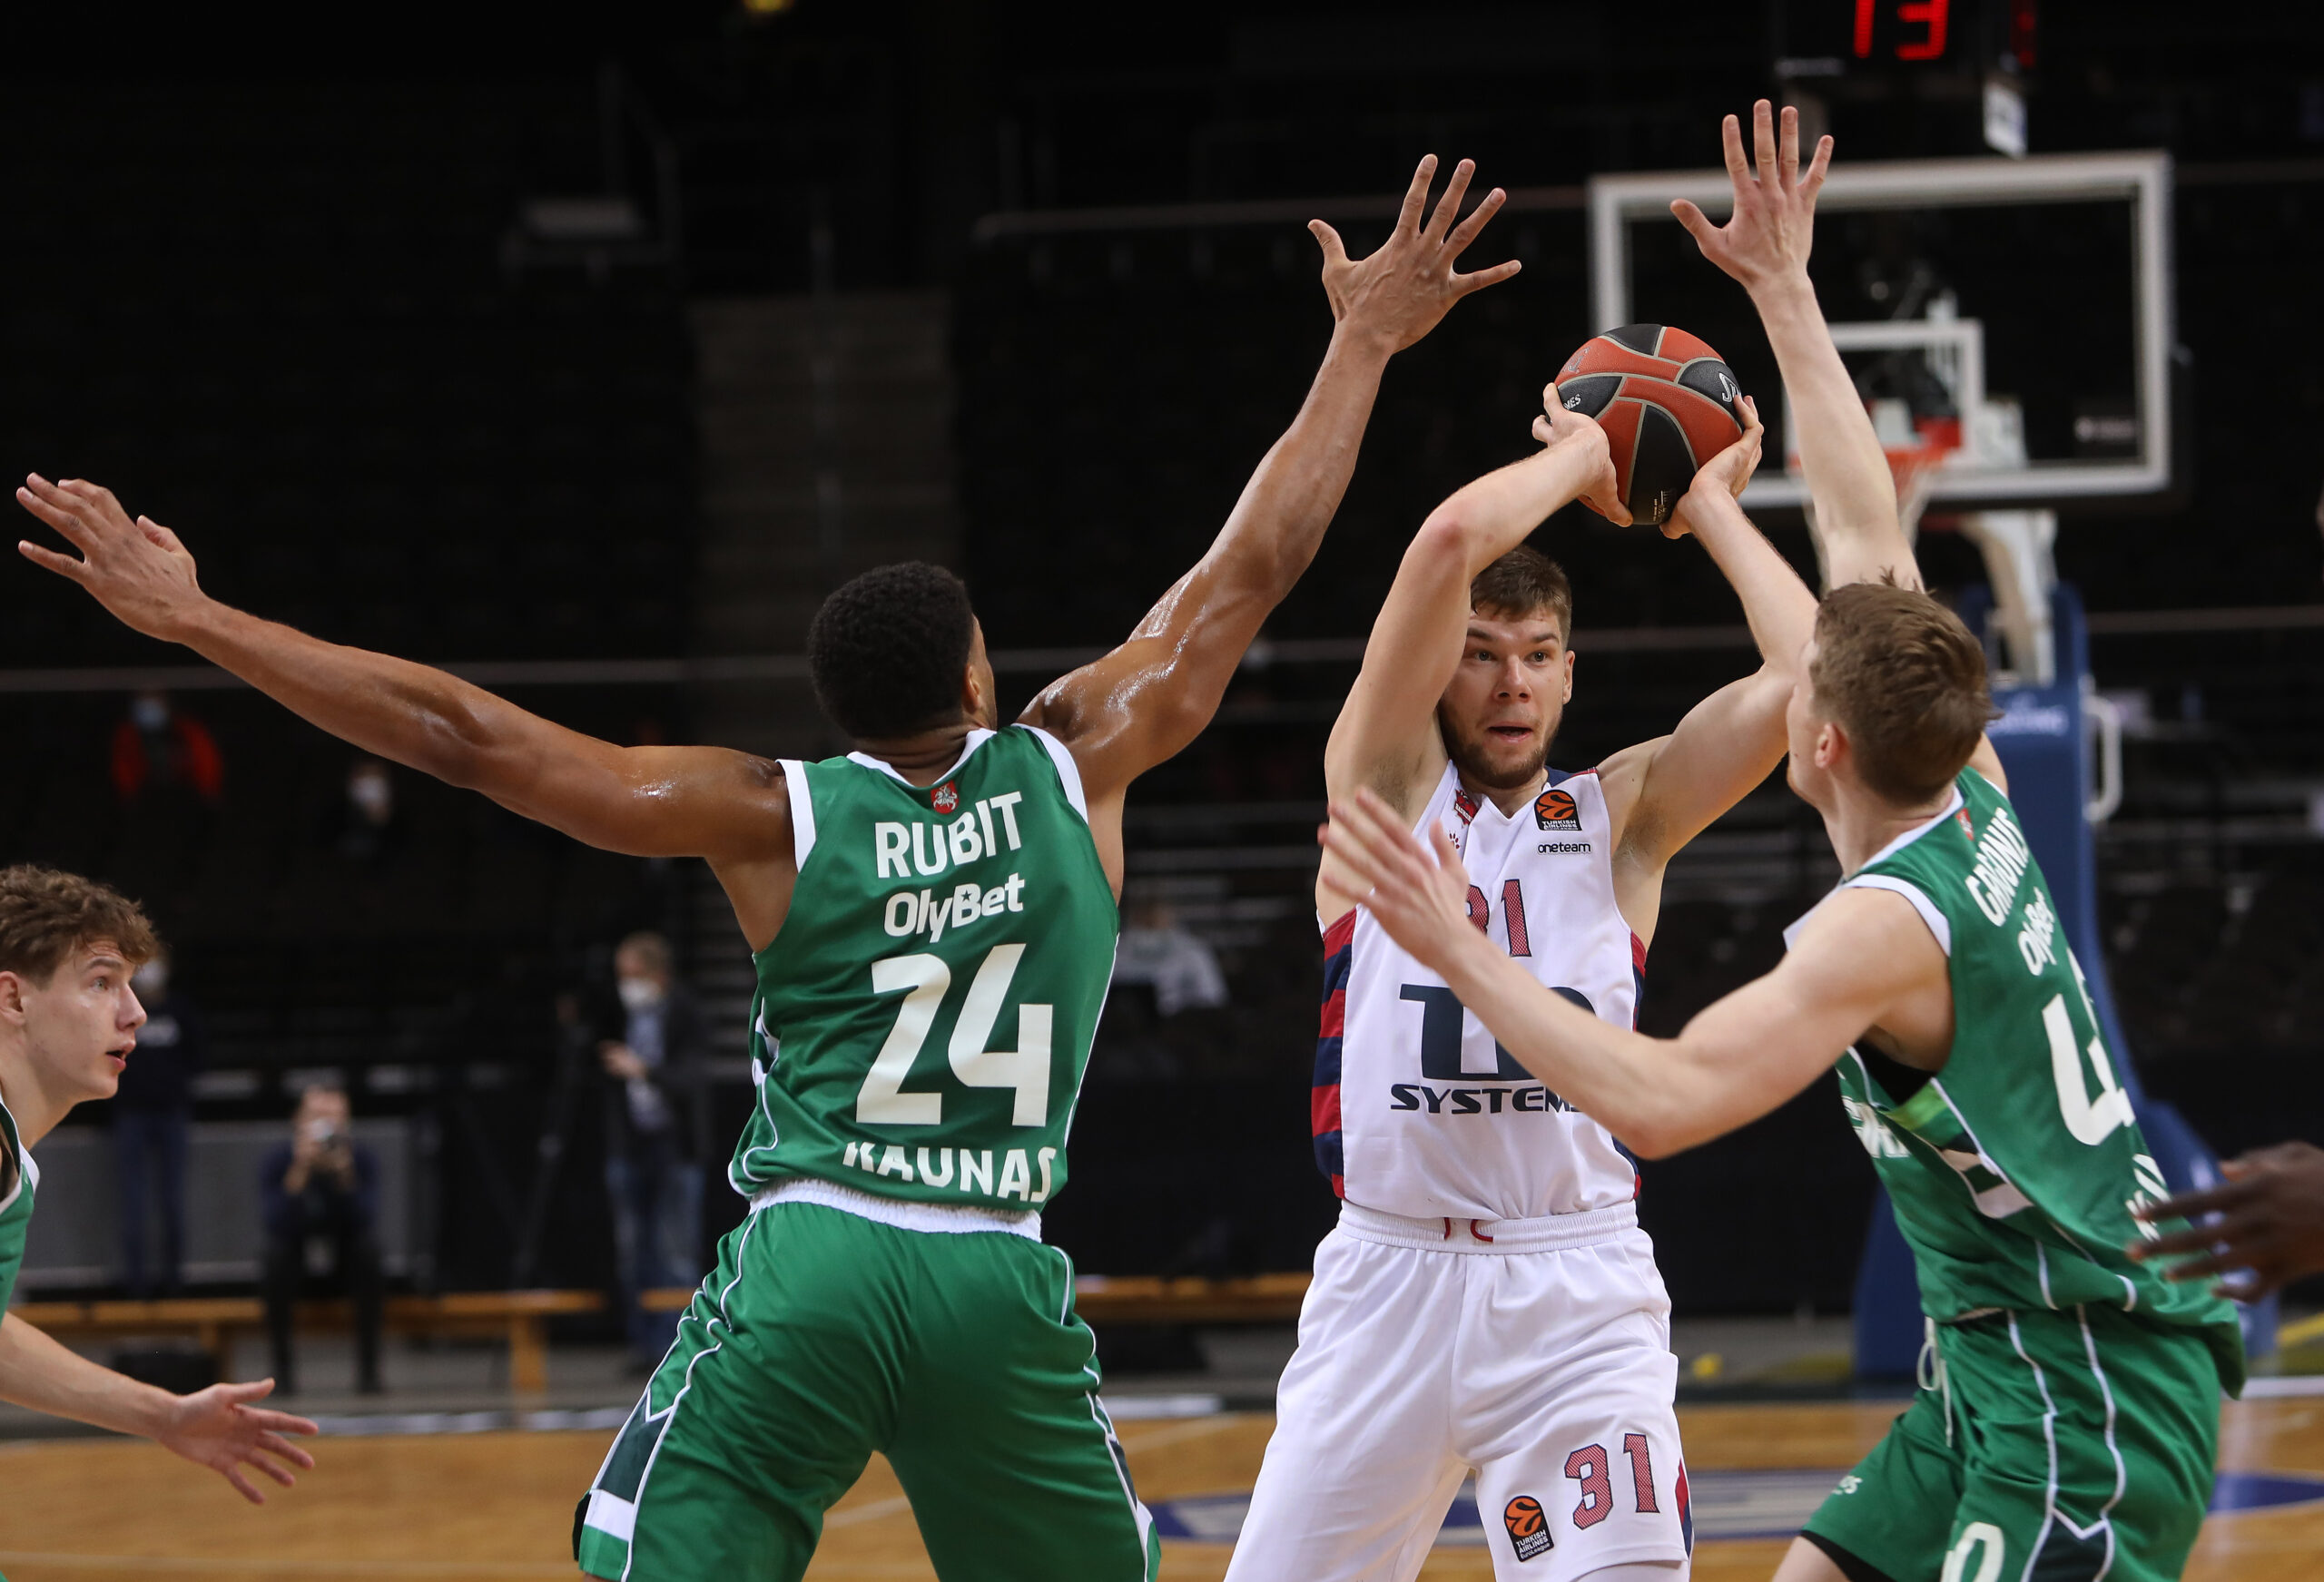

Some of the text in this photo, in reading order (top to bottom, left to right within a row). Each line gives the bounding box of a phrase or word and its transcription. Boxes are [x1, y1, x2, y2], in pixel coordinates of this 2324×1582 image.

[875, 791, 1023, 879] RUBIT
[1538, 841, 1591, 853] oneteam
[884, 872, 1025, 942] OlyBet
[855, 943, 1053, 1127] 24
[1390, 1084, 1585, 1115] SYSTEM
[842, 1141, 1057, 1203] KAUNAS
[1564, 1433, 1660, 1530] 31
[1516, 1529, 1547, 1548] TURKISH
[1519, 1536, 1549, 1554] AIRLINES
